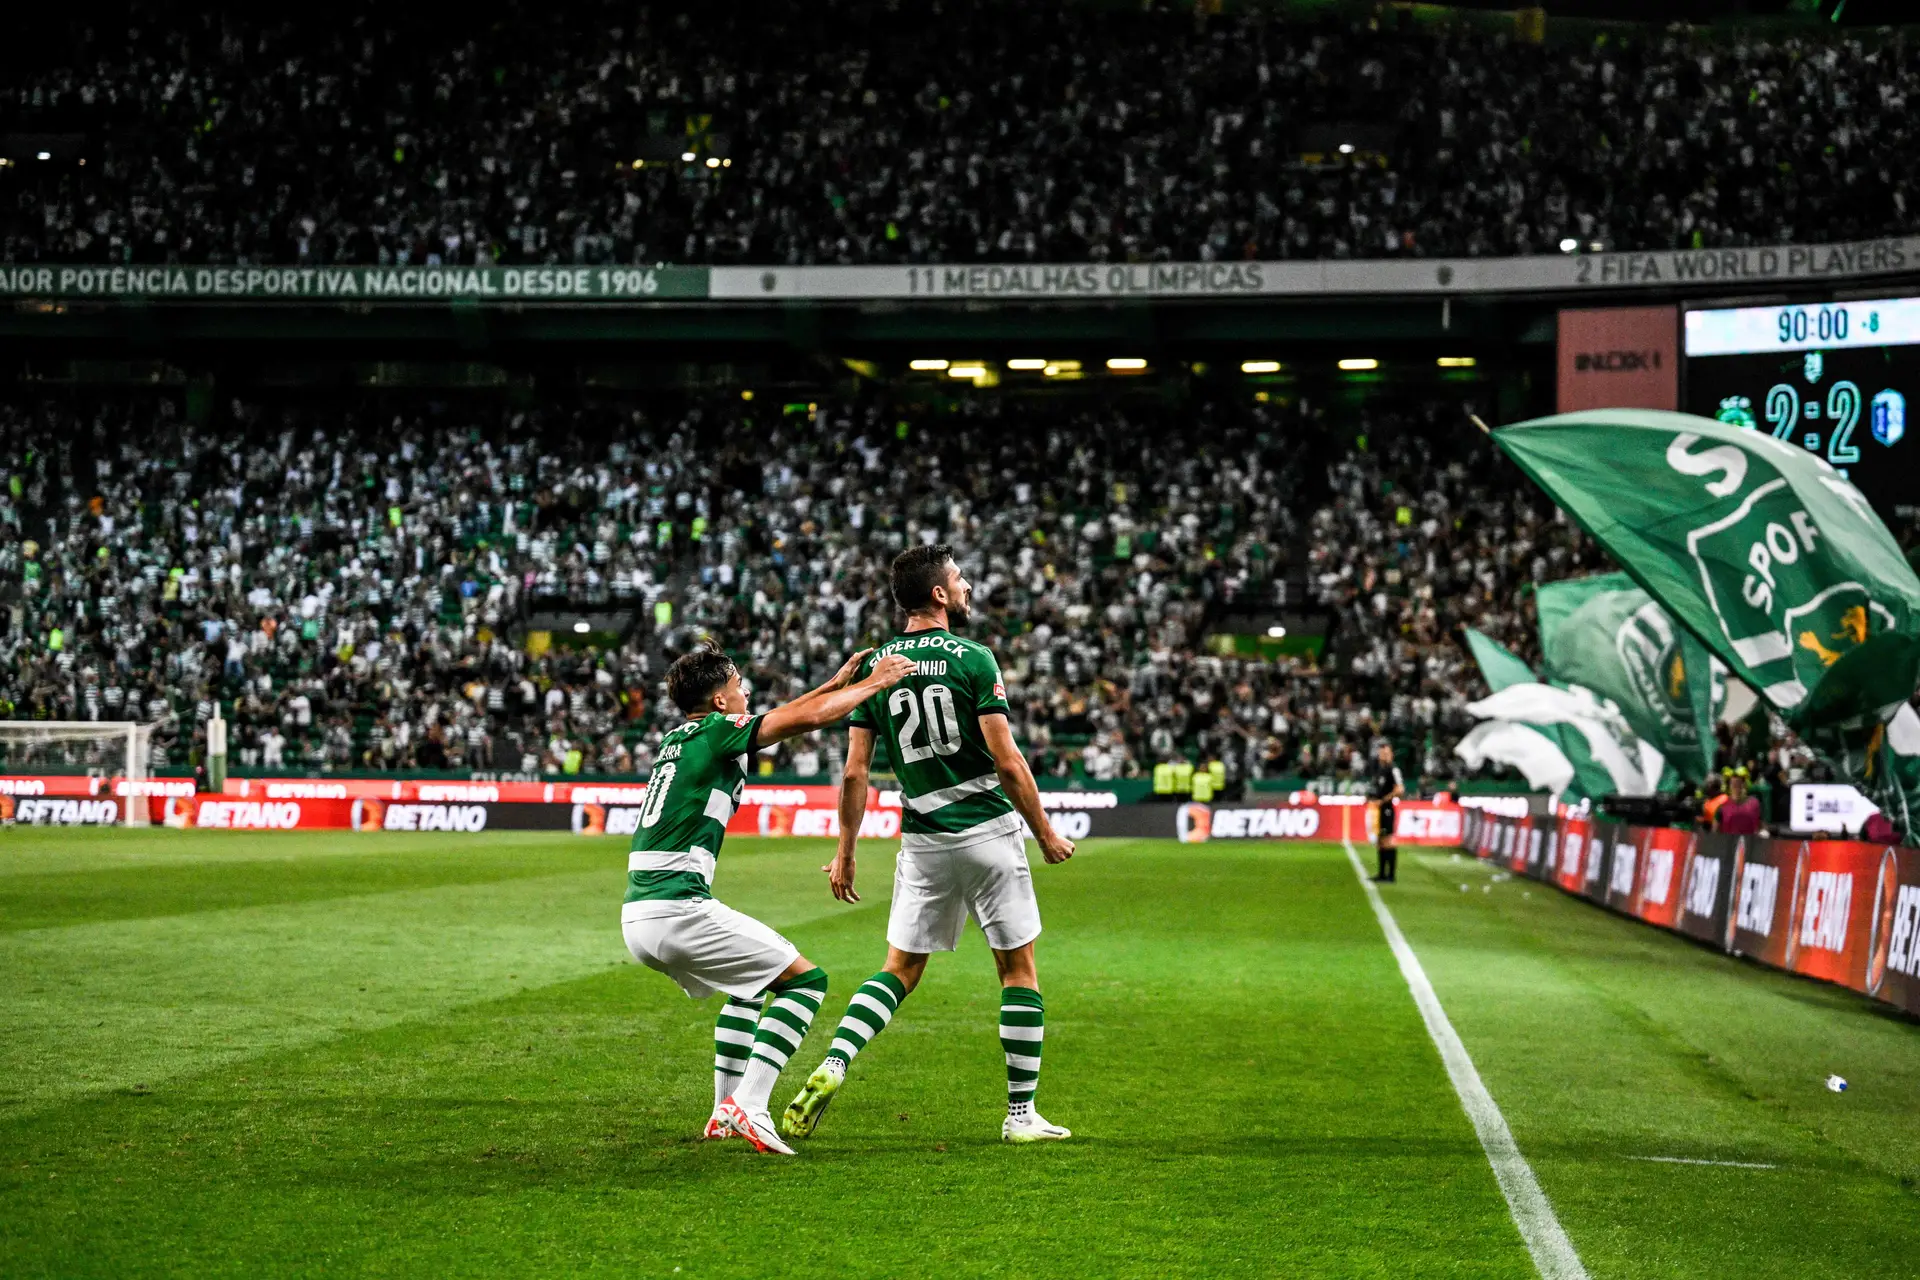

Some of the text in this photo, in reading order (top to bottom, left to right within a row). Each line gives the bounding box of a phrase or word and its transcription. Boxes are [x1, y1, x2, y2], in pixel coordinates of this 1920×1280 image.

[1576, 240, 1905, 282] 2 FIFA WORLD PLAYERS
[60, 266, 189, 293] POTÊNCIA
[195, 269, 358, 294] DESPORTIVA
[364, 270, 496, 294] NACIONAL
[504, 270, 590, 294] DESDE
[598, 270, 658, 294] 1906
[907, 268, 935, 293] 11
[943, 267, 1098, 292] MEDALHAS
[1779, 308, 1848, 342] 90:00
[1765, 380, 1862, 464] 2:2
[869, 636, 970, 668] SUPER BOCK
[888, 684, 962, 764] 20
[197, 801, 300, 829] BETANO
[384, 804, 487, 832] BETANO
[792, 809, 900, 838] BETNO
[1211, 808, 1319, 837] BETANO
